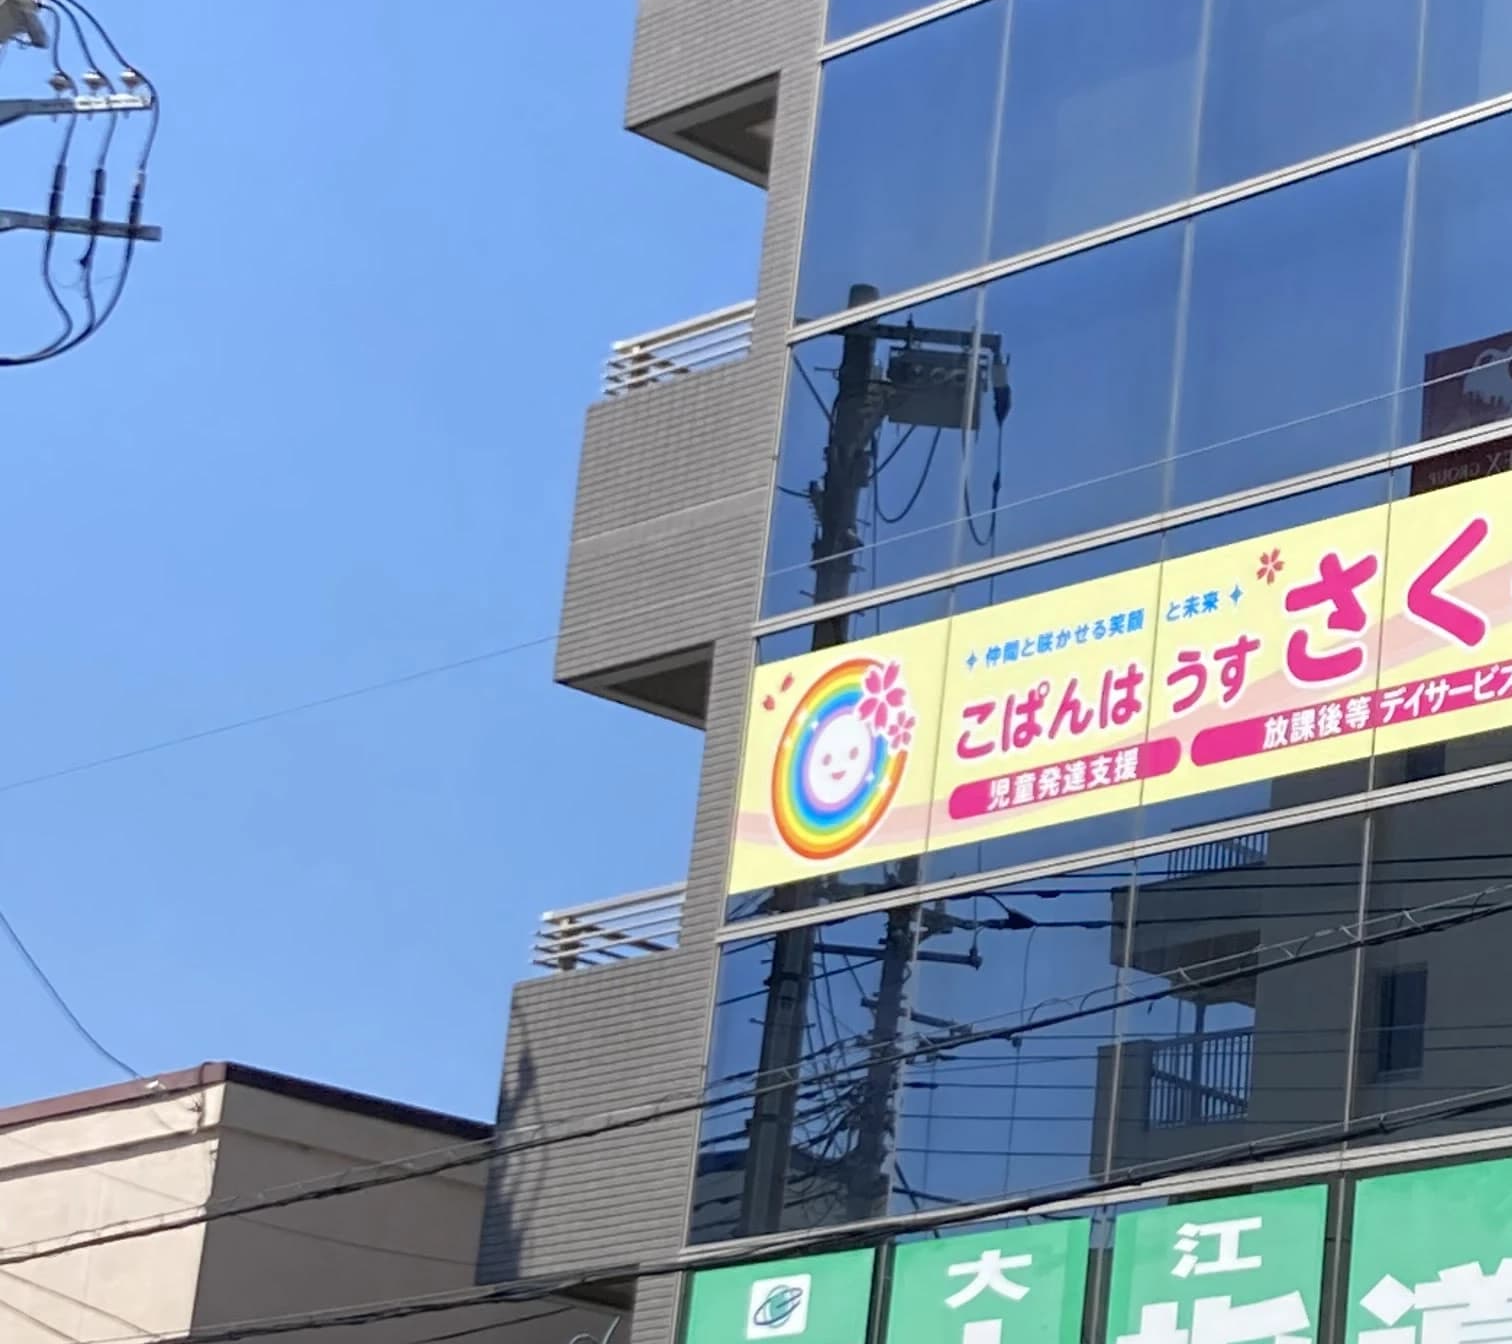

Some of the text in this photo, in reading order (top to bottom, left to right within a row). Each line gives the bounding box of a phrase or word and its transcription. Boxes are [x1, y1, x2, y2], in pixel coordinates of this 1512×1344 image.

[956, 635, 1261, 761] こぱんはうす
[987, 748, 1139, 811] 児童発達支援
